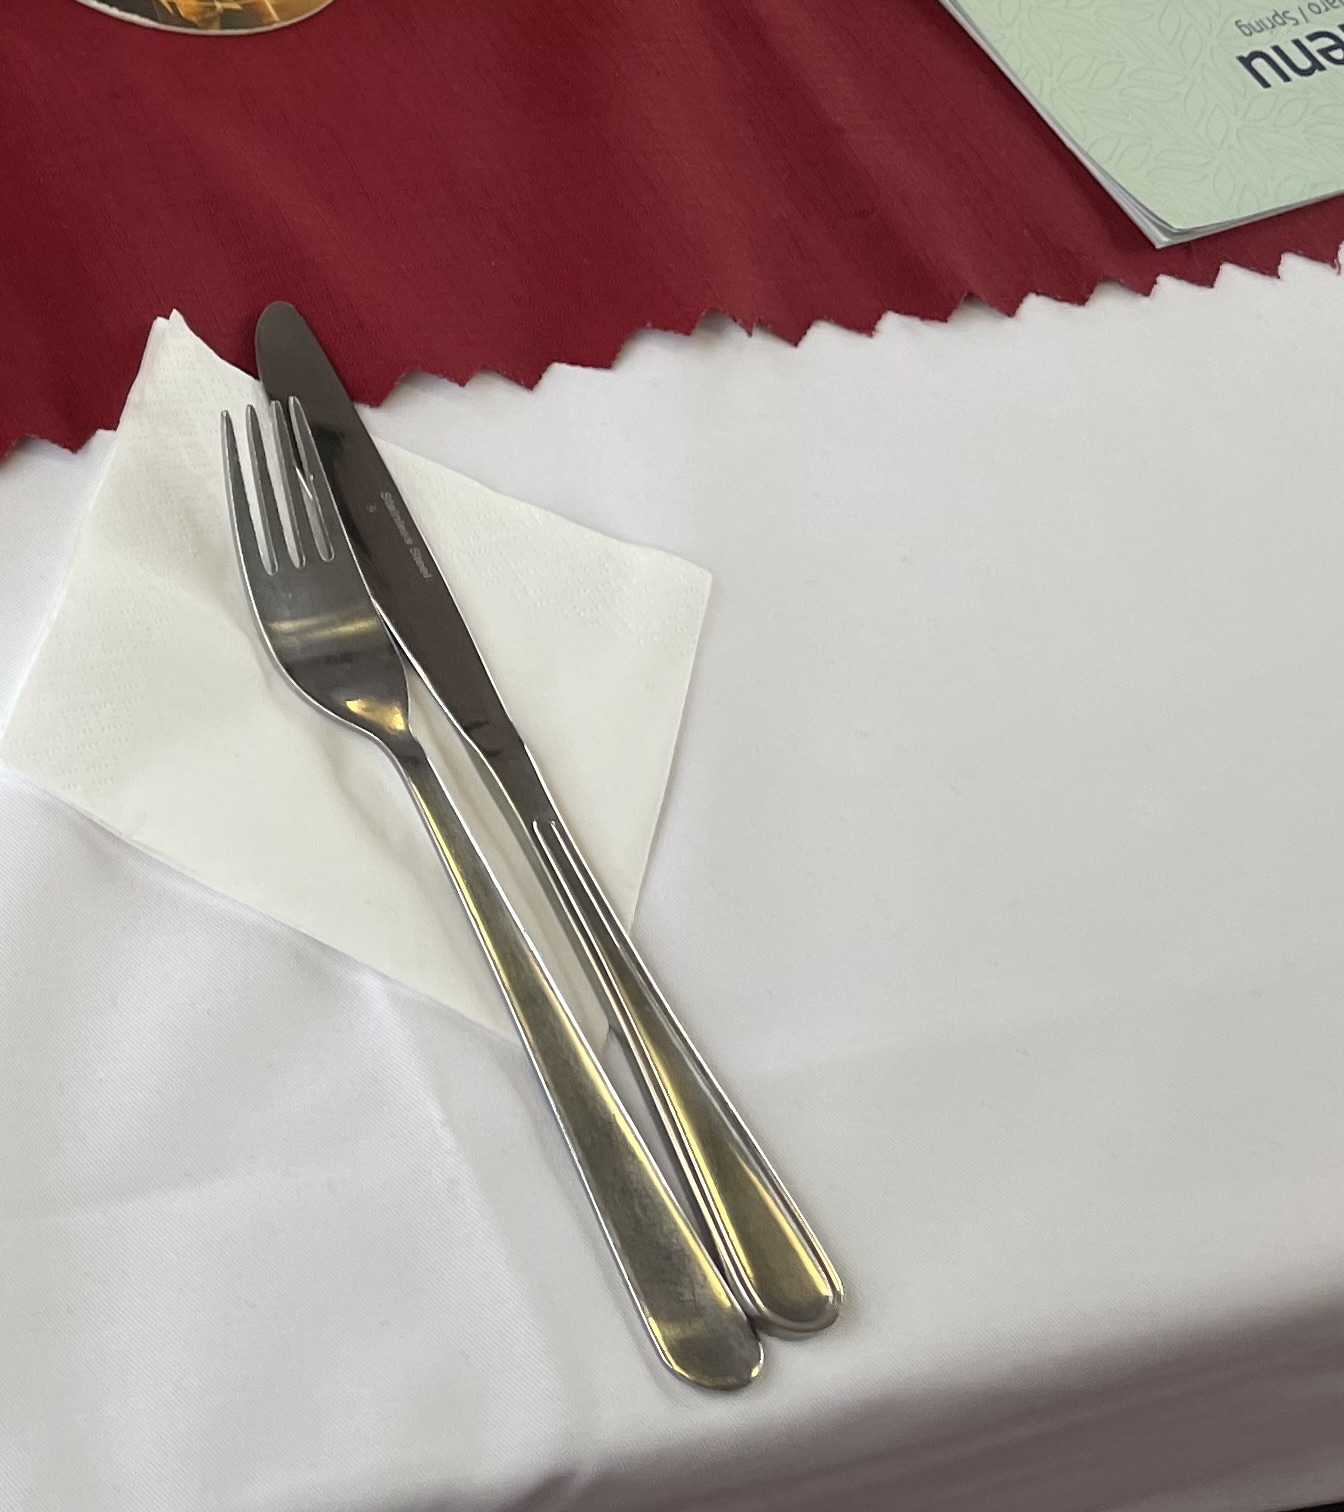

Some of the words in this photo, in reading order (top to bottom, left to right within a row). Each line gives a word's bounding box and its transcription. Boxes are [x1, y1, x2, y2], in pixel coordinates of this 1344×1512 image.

[1234, 9, 1300, 37] Spring
[1236, 23, 1344, 88] enu
[409, 547, 434, 579] Steel
